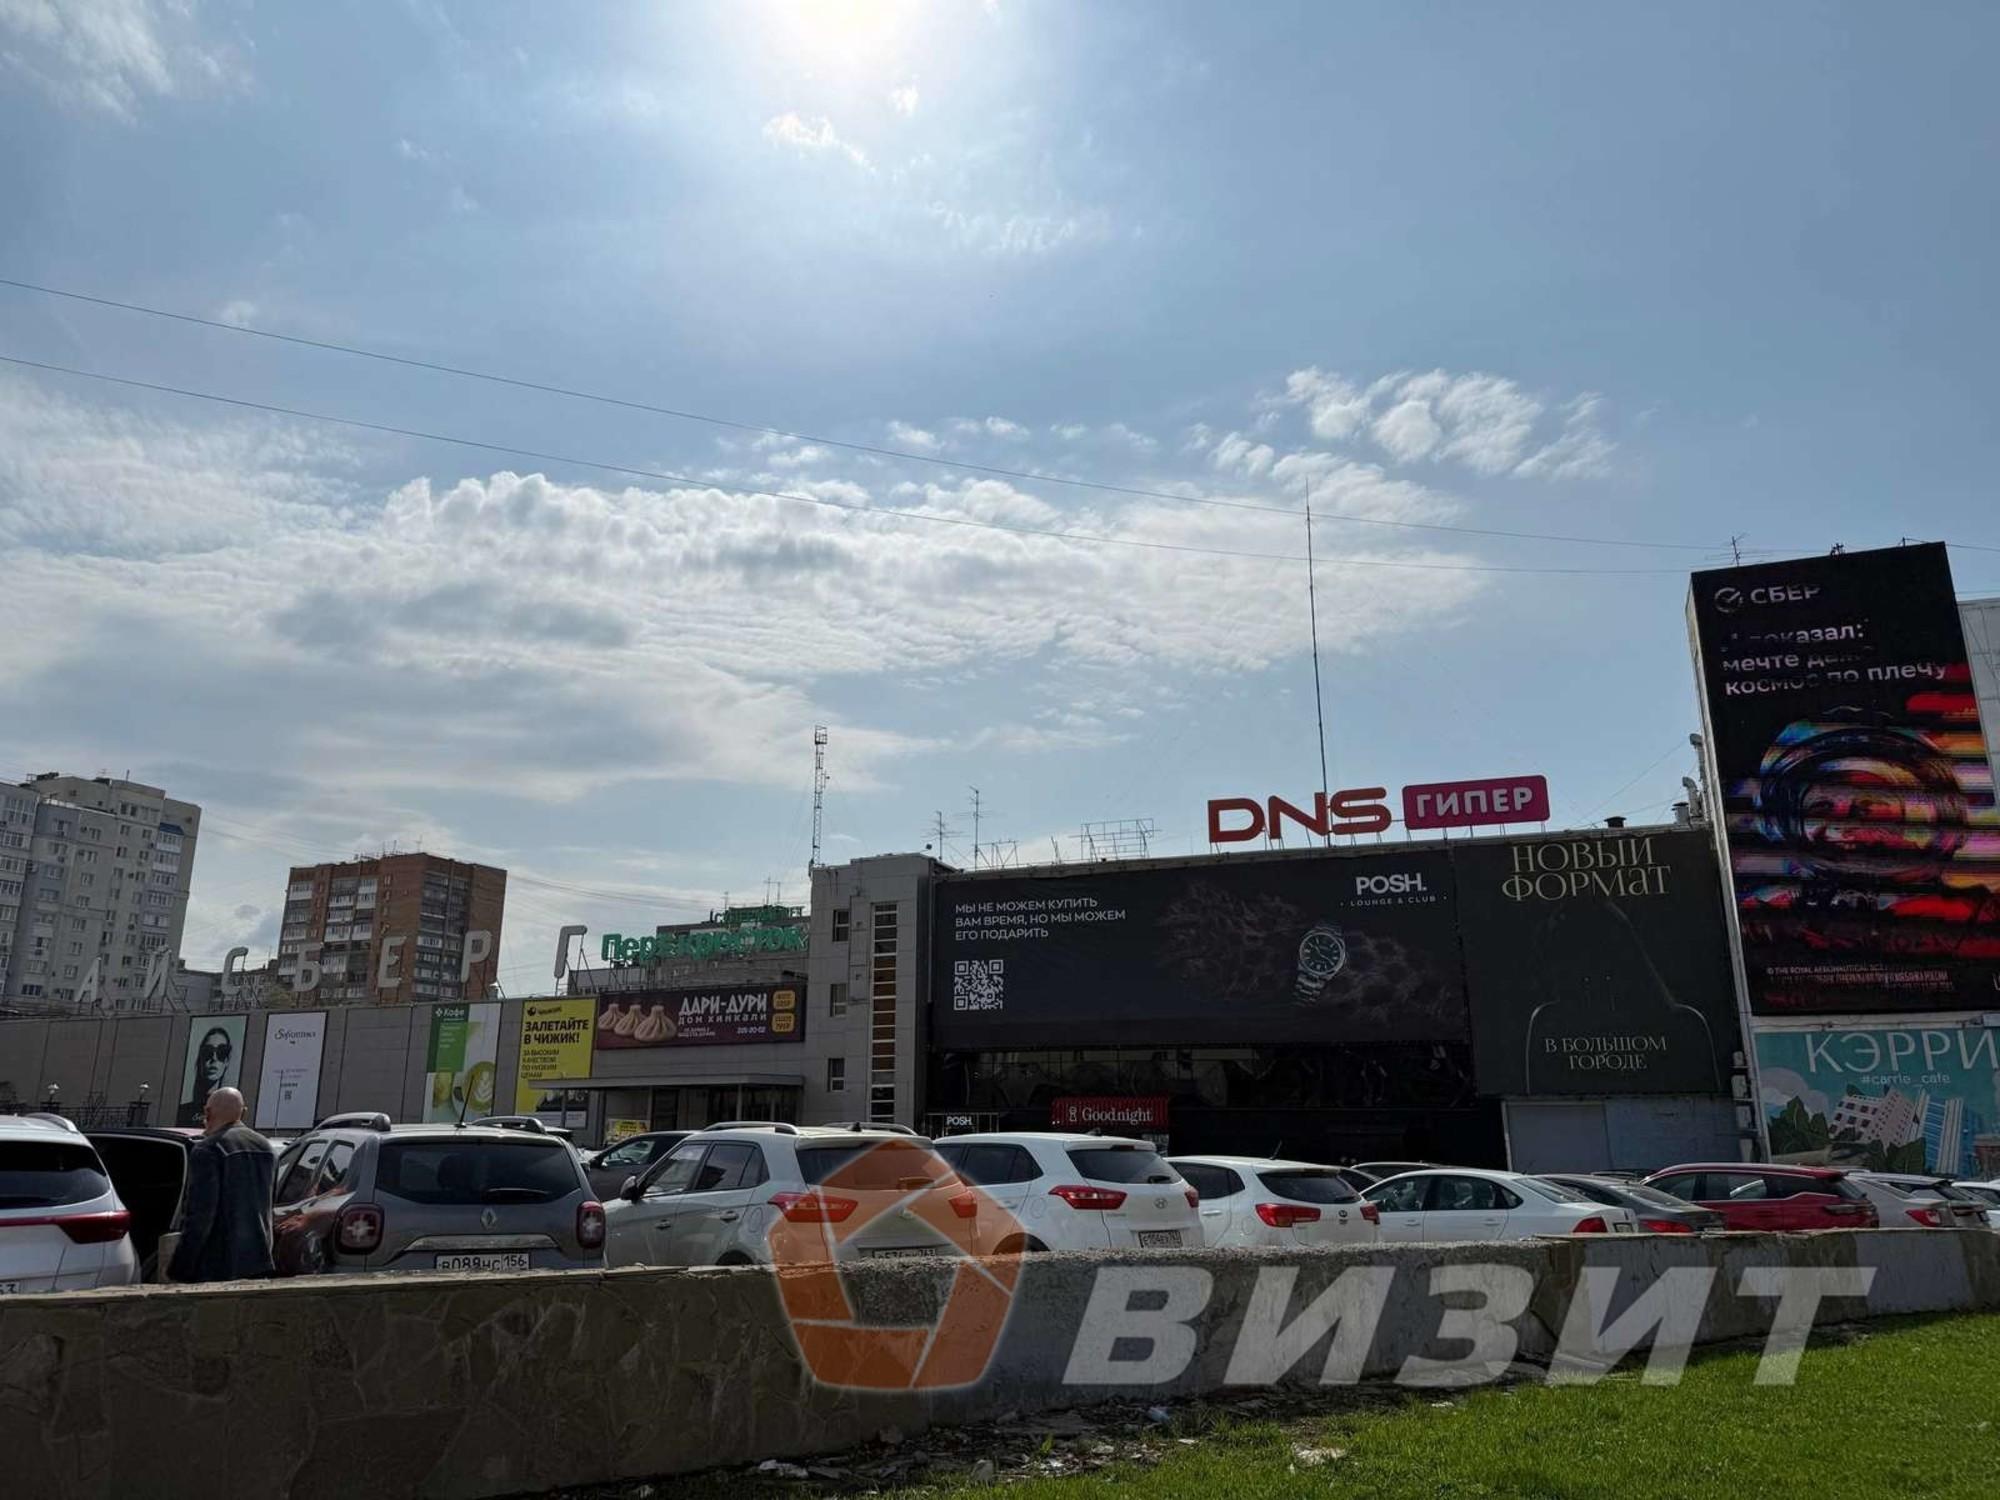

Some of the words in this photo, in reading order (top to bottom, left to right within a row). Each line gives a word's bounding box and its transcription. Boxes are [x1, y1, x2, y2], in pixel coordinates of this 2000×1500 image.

[1750, 584, 1820, 604] СБЕР
[1723, 653, 1799, 672] мечте
[1867, 661, 1948, 681] плечу
[1416, 787, 1533, 818] ГИПЕР
[1208, 787, 1392, 842] DNS
[1511, 833, 1655, 872] НОВЫЙ
[955, 904, 976, 914] МЫ
[978, 902, 994, 912] НЕ
[996, 900, 1045, 911] МОЖЕМ
[1048, 898, 1098, 909] КУПИТЬ
[1350, 898, 1392, 907] LOUNGE
[1407, 895, 1436, 904] CLUB
[955, 917, 981, 927] ВАМ
[983, 914, 1028, 926] ВРЕМЯ,
[1030, 913, 1048, 924] НО
[1051, 913, 1070, 923] МЫ
[1074, 910, 1126, 921] МОЖЕМ
[955, 930, 978, 941] ЕГО
[980, 928, 1049, 940] ПОДАРИТЬ
[77, 925, 586, 1002] АЙСБЕРГ
[678, 993, 767, 1016] ДАРИ-ДУРИ
[525, 1017, 589, 1031] ЗАЛЕТАЙТЕ
[524, 1034, 531, 1044] В
[534, 1032, 580, 1044] ЧИЖИК!
[1545, 1038, 1557, 1052] В
[1561, 1036, 1667, 1052] БОЛЬШОМ
[1805, 1029, 2000, 1073] КЭРРИ
[1569, 1053, 1648, 1071] ГОРОДЕ
[1081, 1107, 1153, 1126] Goodnight
[503, 1254, 525, 1267] 156
